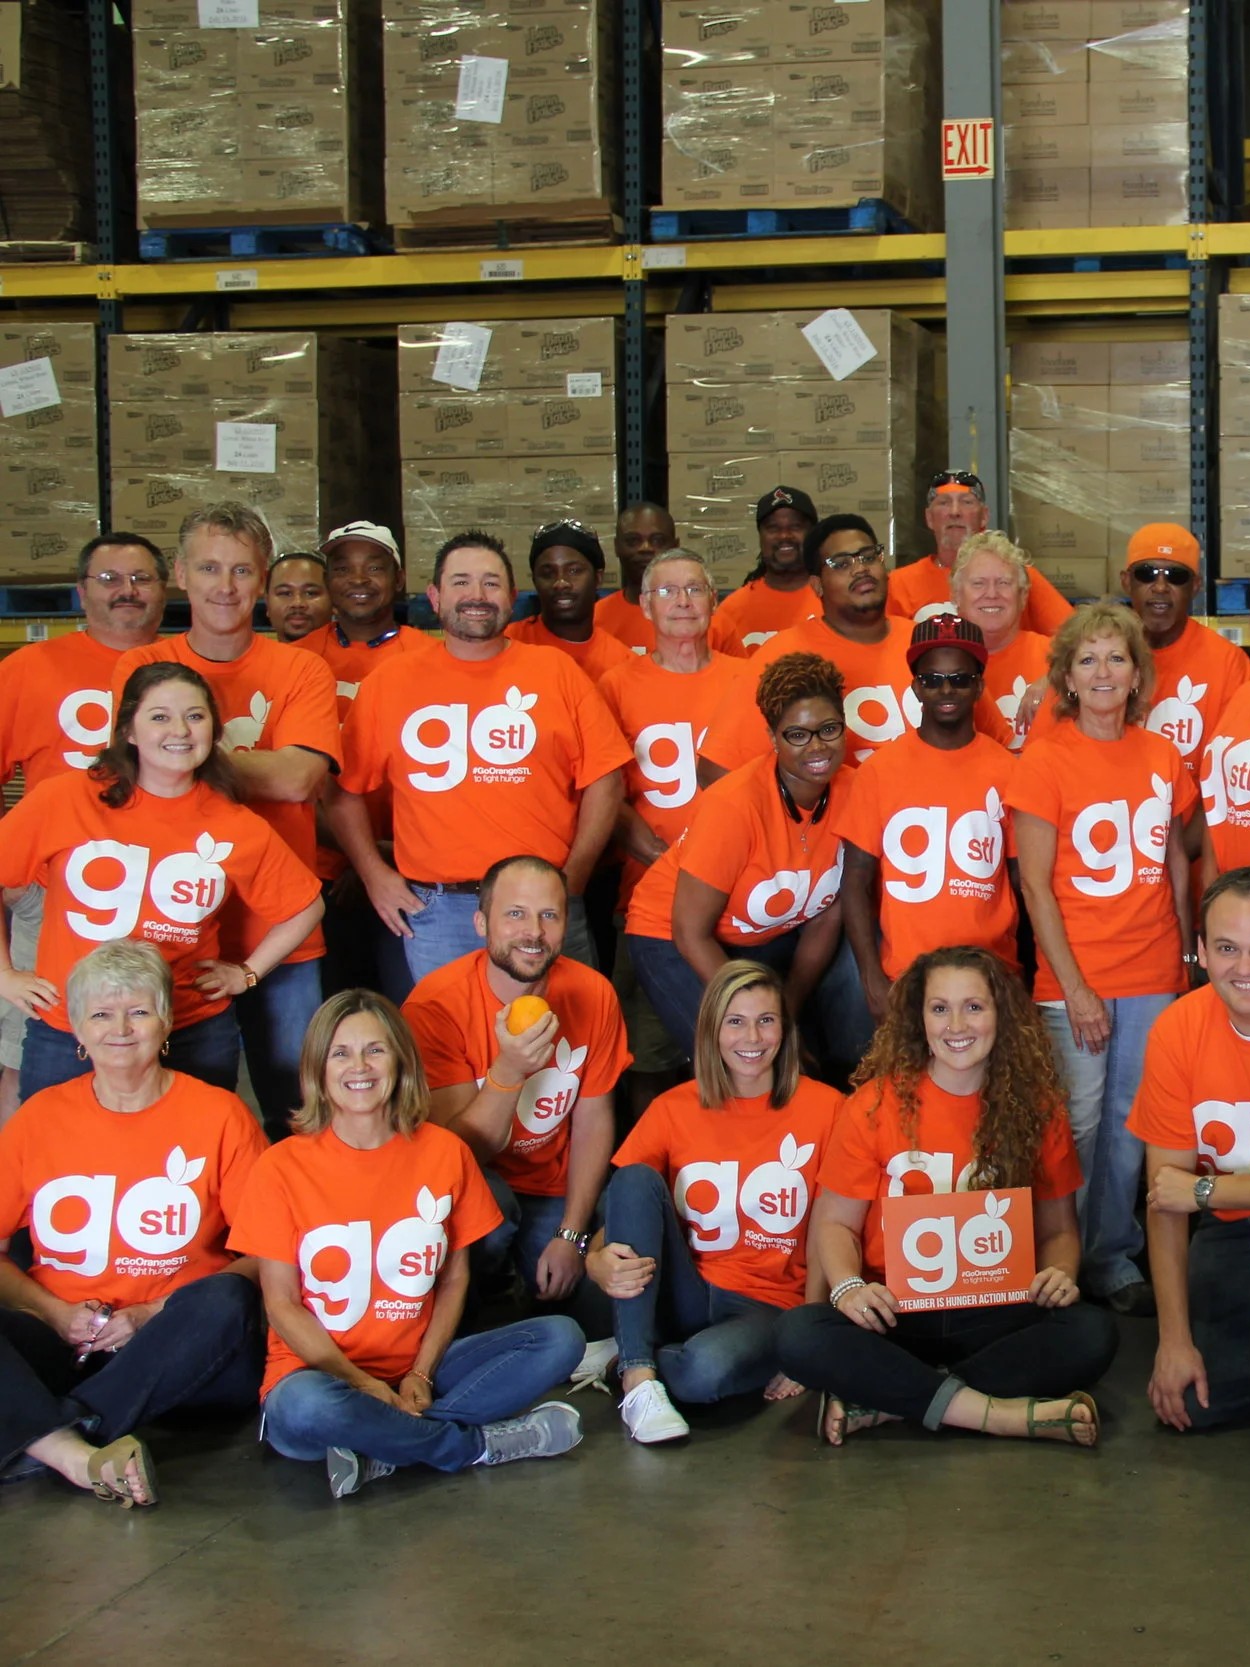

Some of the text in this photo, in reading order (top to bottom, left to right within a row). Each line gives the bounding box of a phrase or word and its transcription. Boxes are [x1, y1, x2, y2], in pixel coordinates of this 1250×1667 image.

[943, 123, 993, 166] EXIT
[488, 724, 525, 749] stl
[1160, 717, 1193, 744] stl
[472, 767, 532, 775] #GoOrangeSTL
[474, 775, 525, 784] to fight hunger
[1150, 824, 1170, 847] st
[967, 836, 995, 864] stl
[170, 877, 216, 908] stl
[153, 930, 171, 942] fight
[534, 1088, 573, 1119] stl
[759, 1186, 797, 1217] stl
[140, 1203, 187, 1236] stl
[973, 1230, 1004, 1255] stl
[115, 1255, 188, 1267] #GoOrangeSTL
[117, 1266, 126, 1274] to
[127, 1266, 146, 1277] fight
[399, 1243, 446, 1276] stl
[961, 1267, 1010, 1278] #GoOrangeSTL
[374, 1300, 423, 1311] #GoOrang
[899, 1290, 1030, 1310] PTEMBER IS HUNGER ACTION MONT
[376, 1310, 384, 1319] to
[386, 1310, 405, 1321] fight
